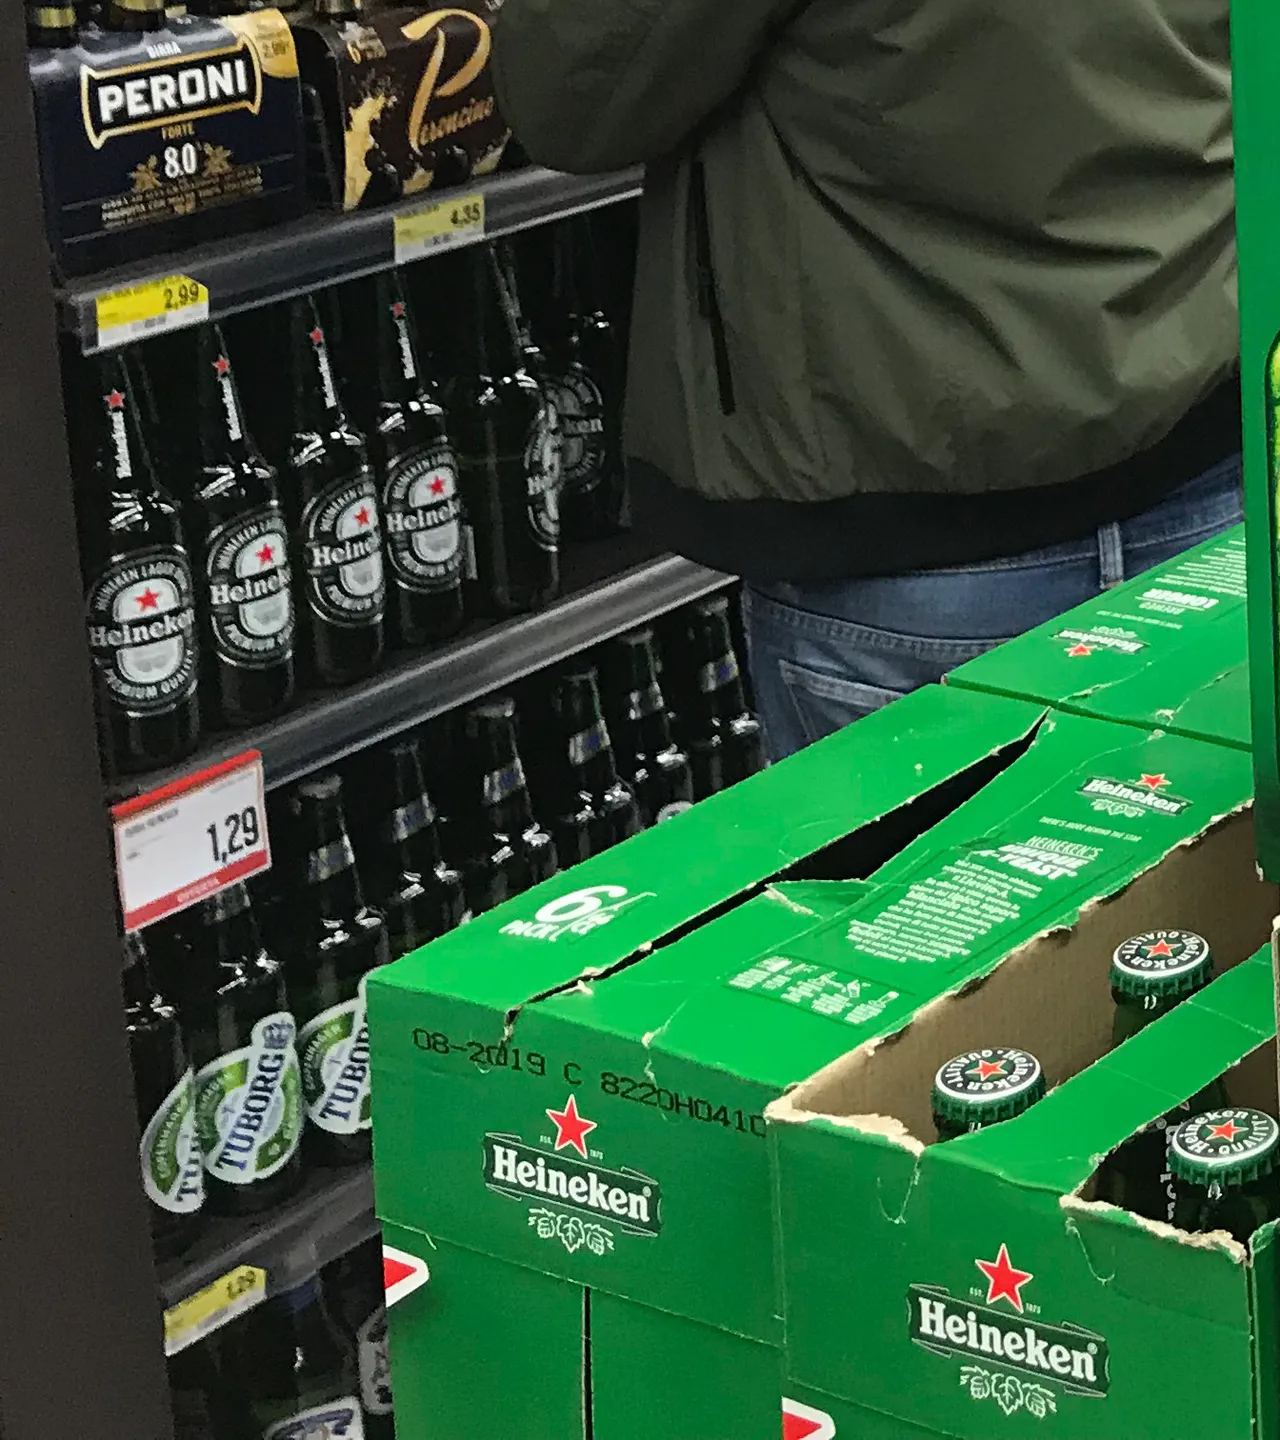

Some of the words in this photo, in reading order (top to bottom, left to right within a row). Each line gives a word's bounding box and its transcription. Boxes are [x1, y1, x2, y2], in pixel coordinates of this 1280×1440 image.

[98, 59, 248, 123] PERONI
[1082, 778, 1183, 813] Heineken
[207, 807, 260, 863] 1,29
[535, 885, 628, 923] 6
[412, 1026, 547, 1078] 08-2019
[564, 1062, 582, 1086] C
[491, 1144, 651, 1223] Heineken
[917, 1296, 1097, 1383] Heineken
